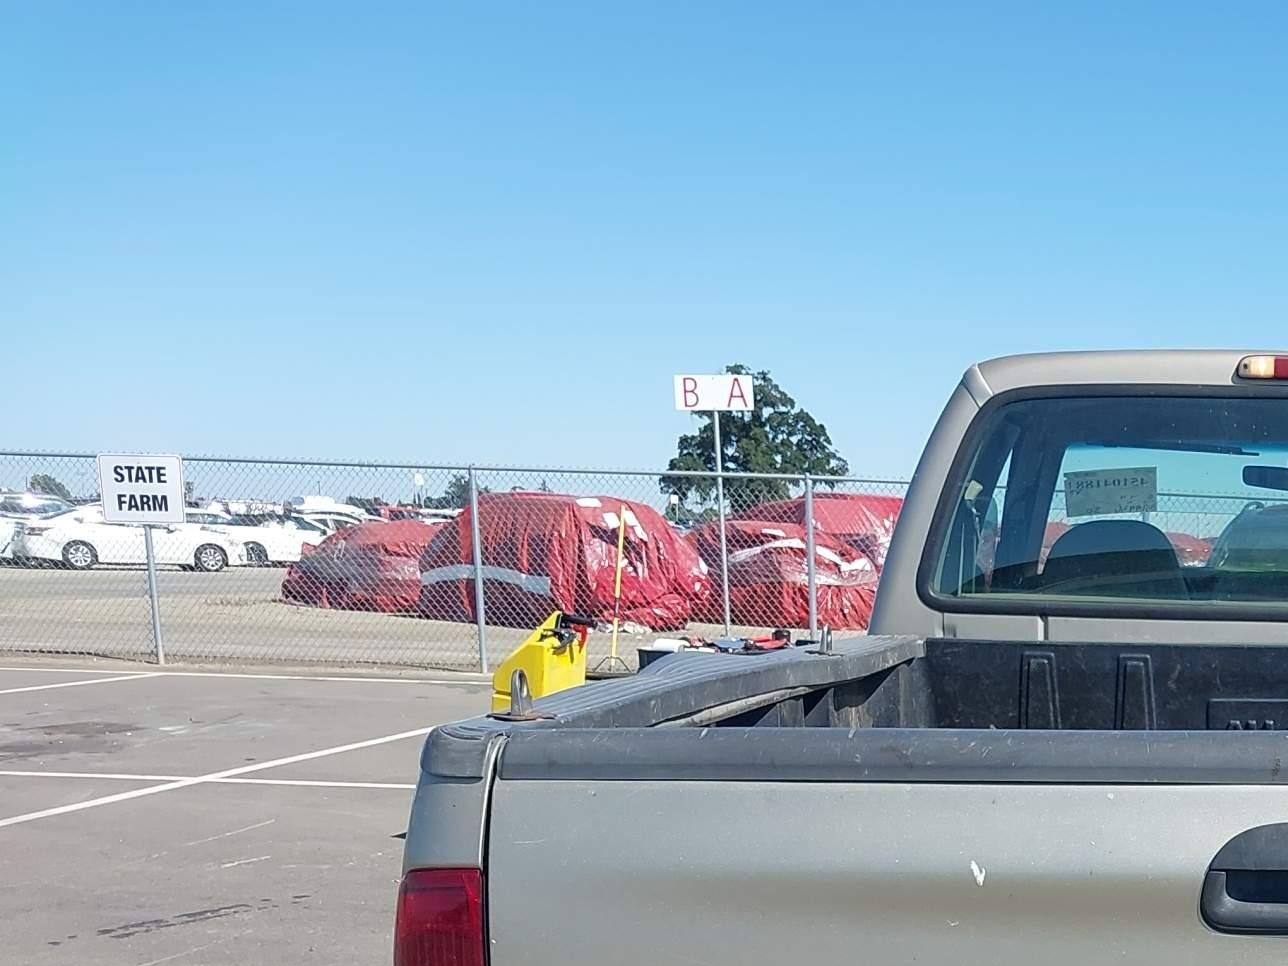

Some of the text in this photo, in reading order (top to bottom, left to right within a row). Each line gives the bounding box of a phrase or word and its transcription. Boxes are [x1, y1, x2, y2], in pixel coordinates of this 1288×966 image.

[682, 377, 748, 408] B A
[113, 465, 167, 484] STATE
[117, 493, 168, 512] FARM
